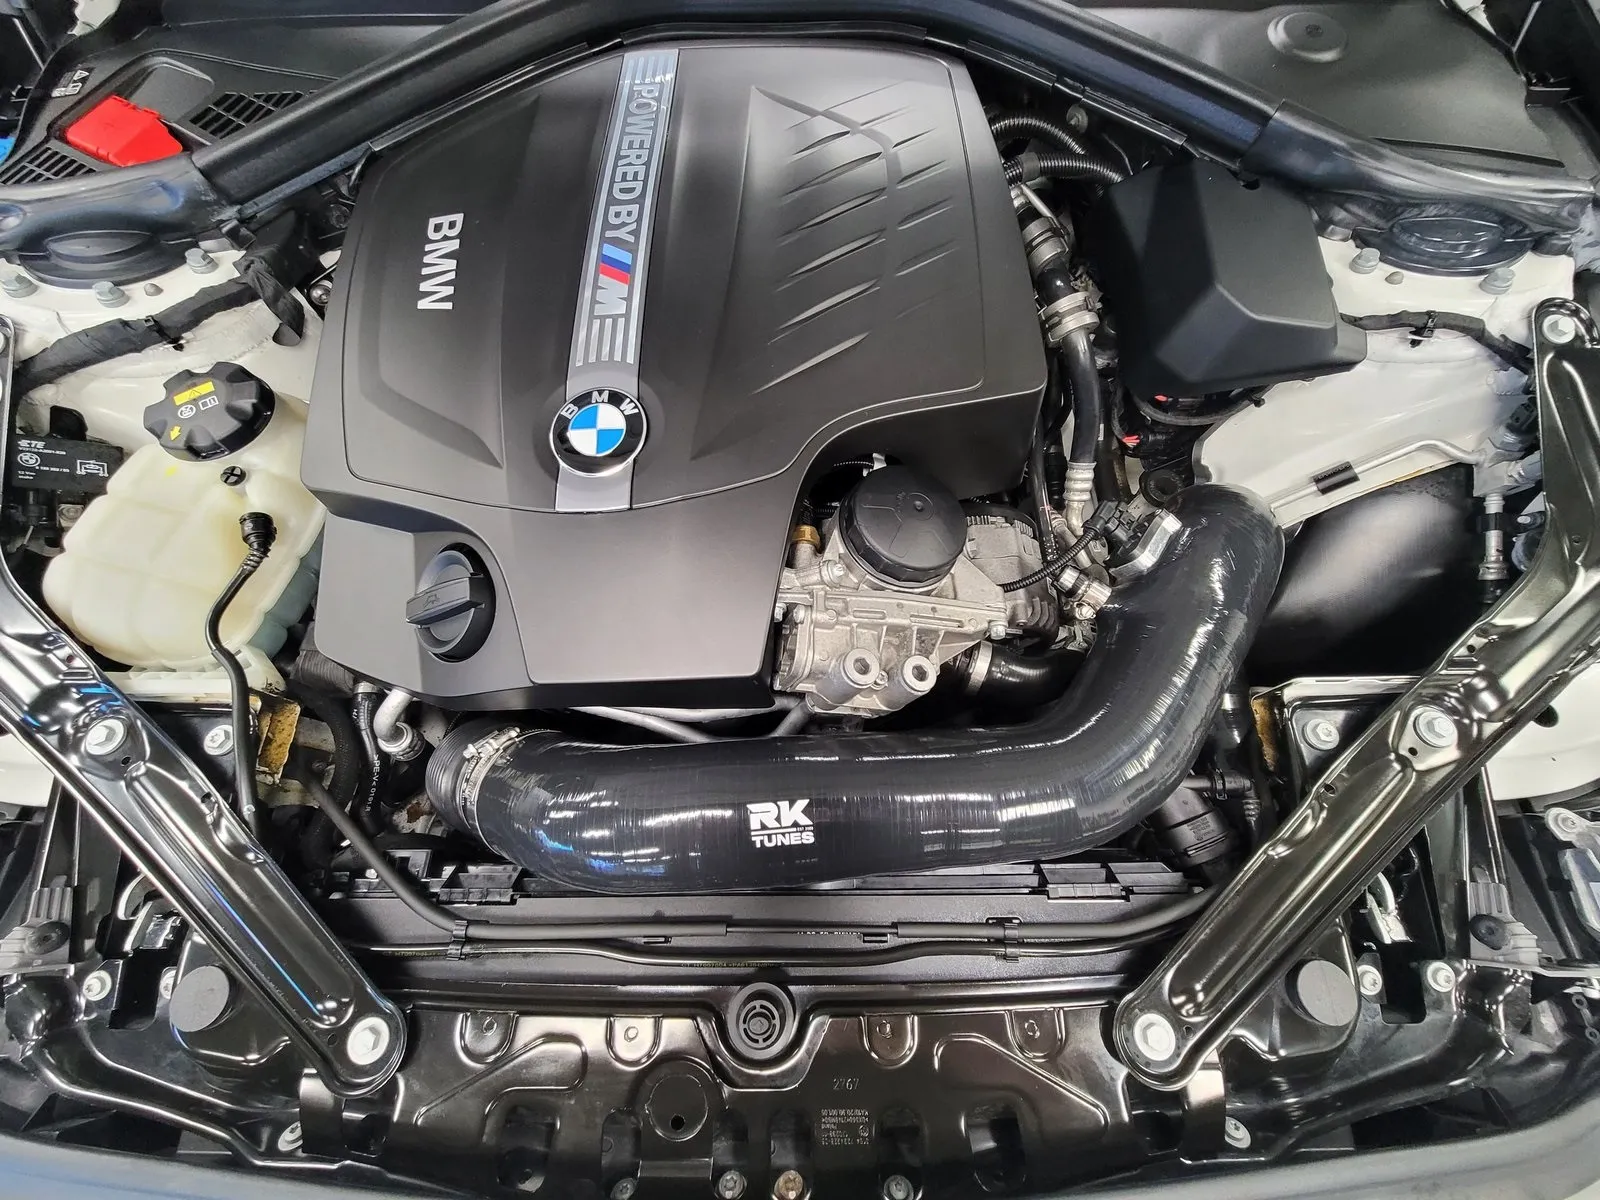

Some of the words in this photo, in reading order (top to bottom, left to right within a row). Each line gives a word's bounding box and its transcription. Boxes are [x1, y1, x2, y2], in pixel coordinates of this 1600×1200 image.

[612, 84, 660, 200] POWERED
[605, 204, 640, 243] BY
[417, 212, 464, 310] BMW
[560, 390, 640, 420] BMW
[746, 798, 814, 830] RK
[751, 831, 815, 848] TUNES
